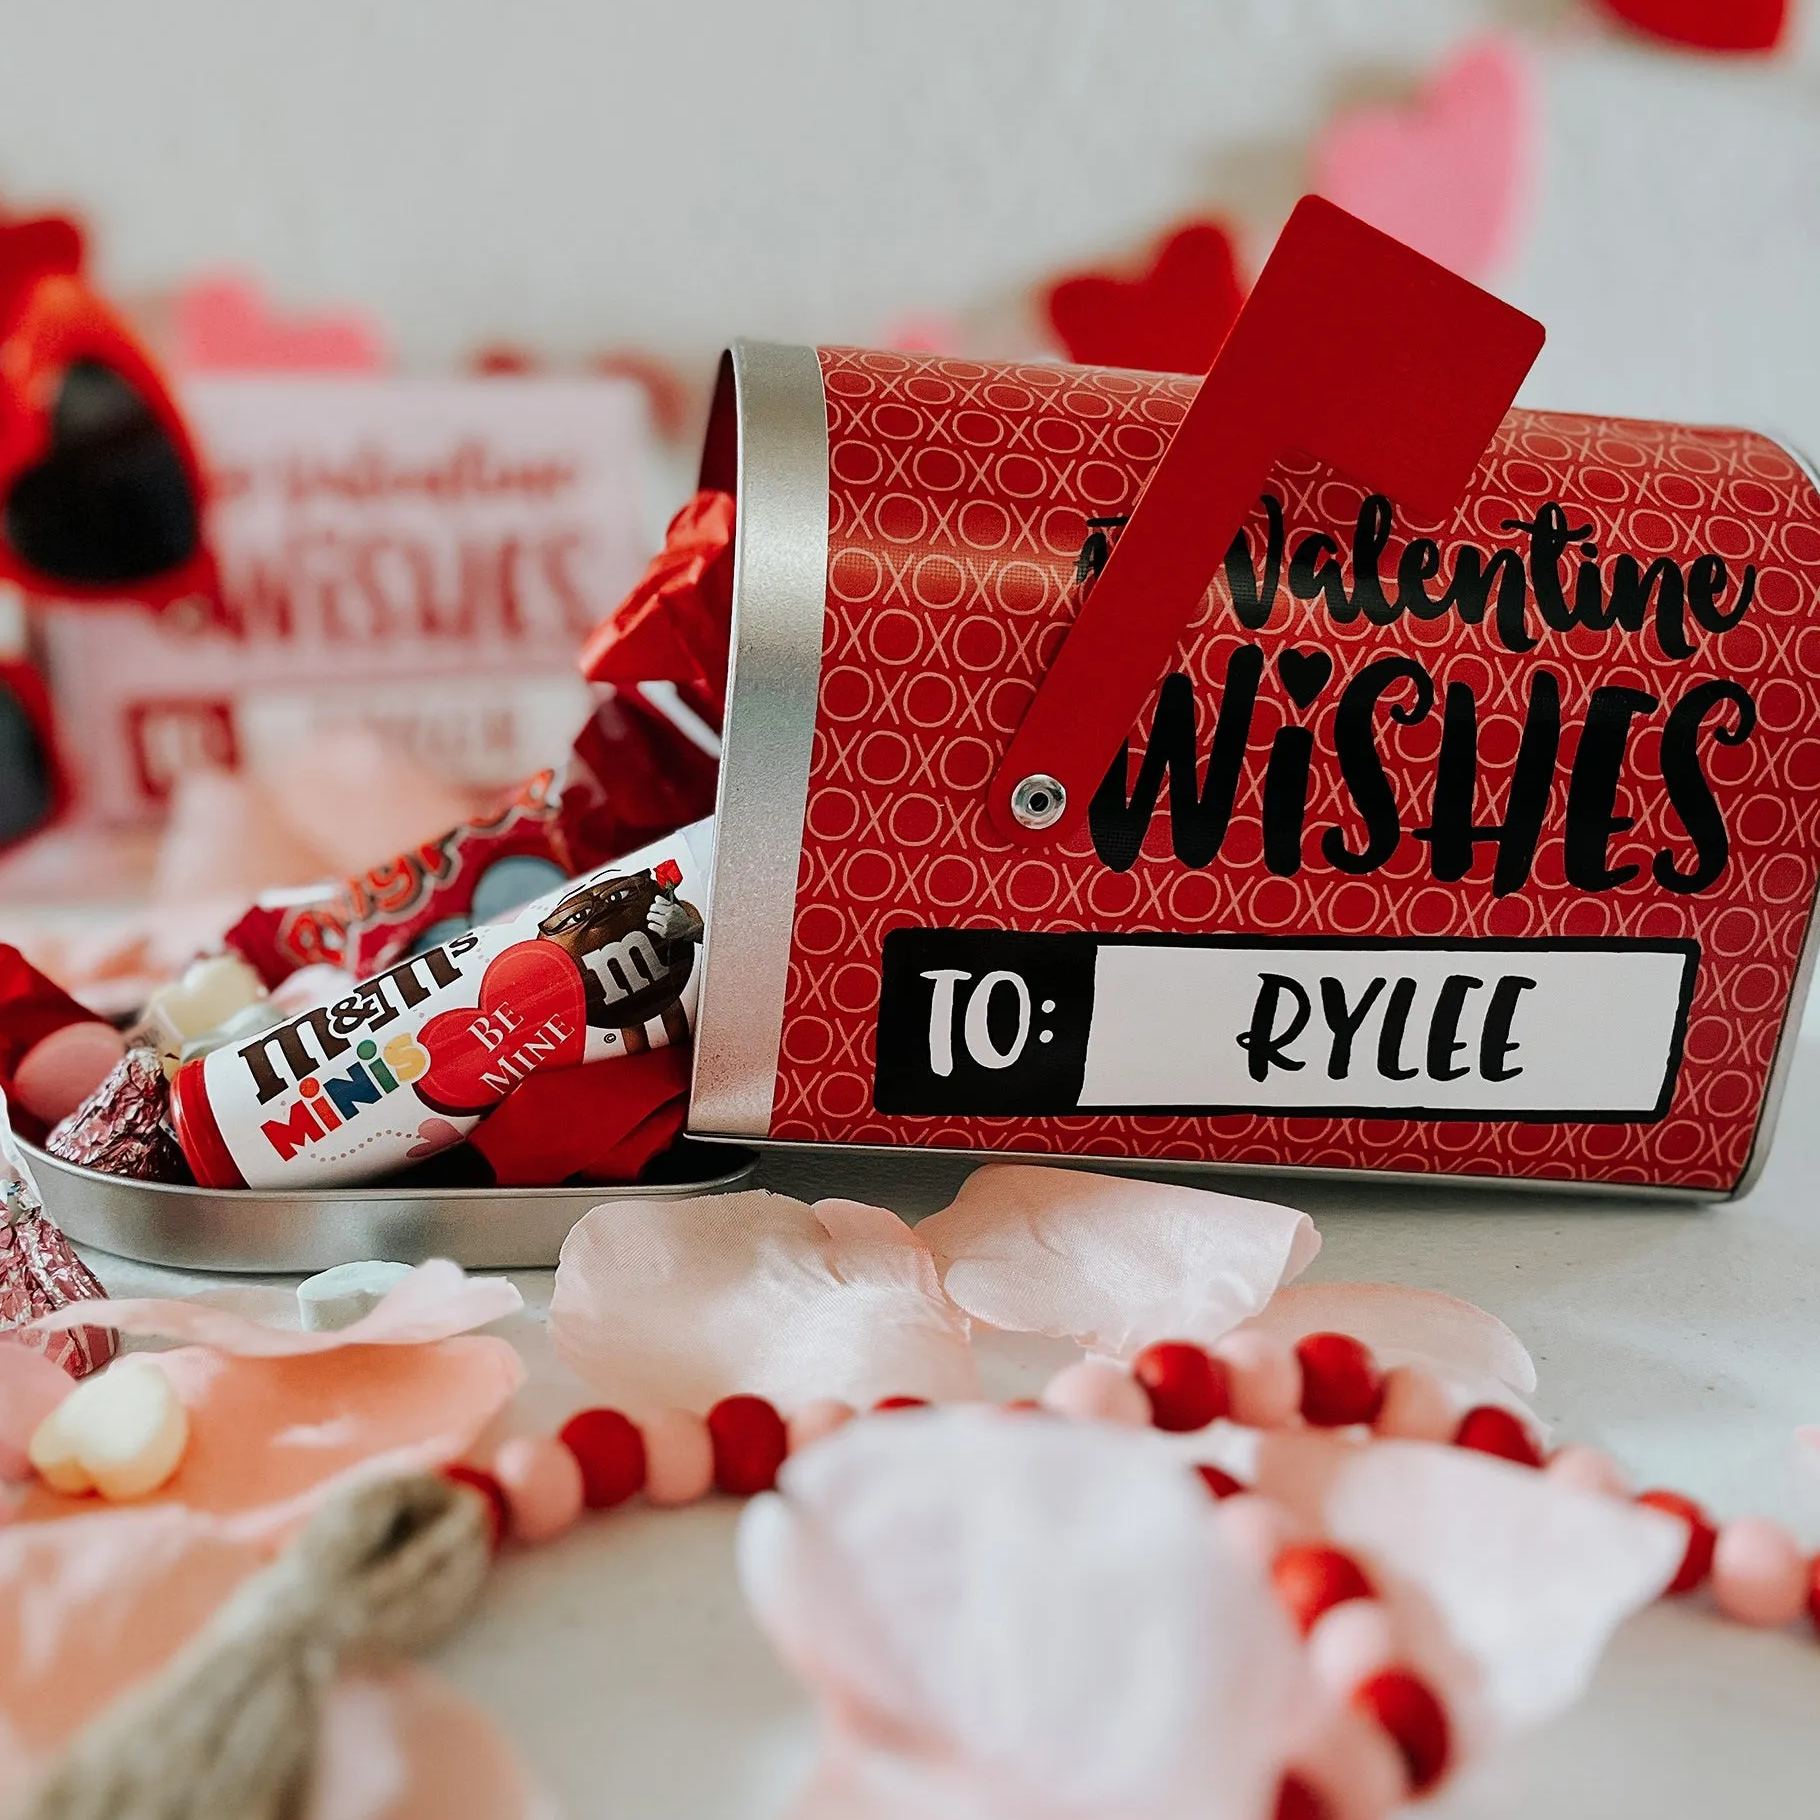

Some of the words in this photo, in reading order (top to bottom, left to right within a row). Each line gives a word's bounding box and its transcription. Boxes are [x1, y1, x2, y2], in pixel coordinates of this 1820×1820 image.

[1224, 494, 1755, 660] Valentine
[466, 1001, 525, 1053] BE
[479, 1013, 576, 1096] MINE
[919, 969, 1056, 1077] TO:
[1235, 972, 1537, 1084] RYLEE
